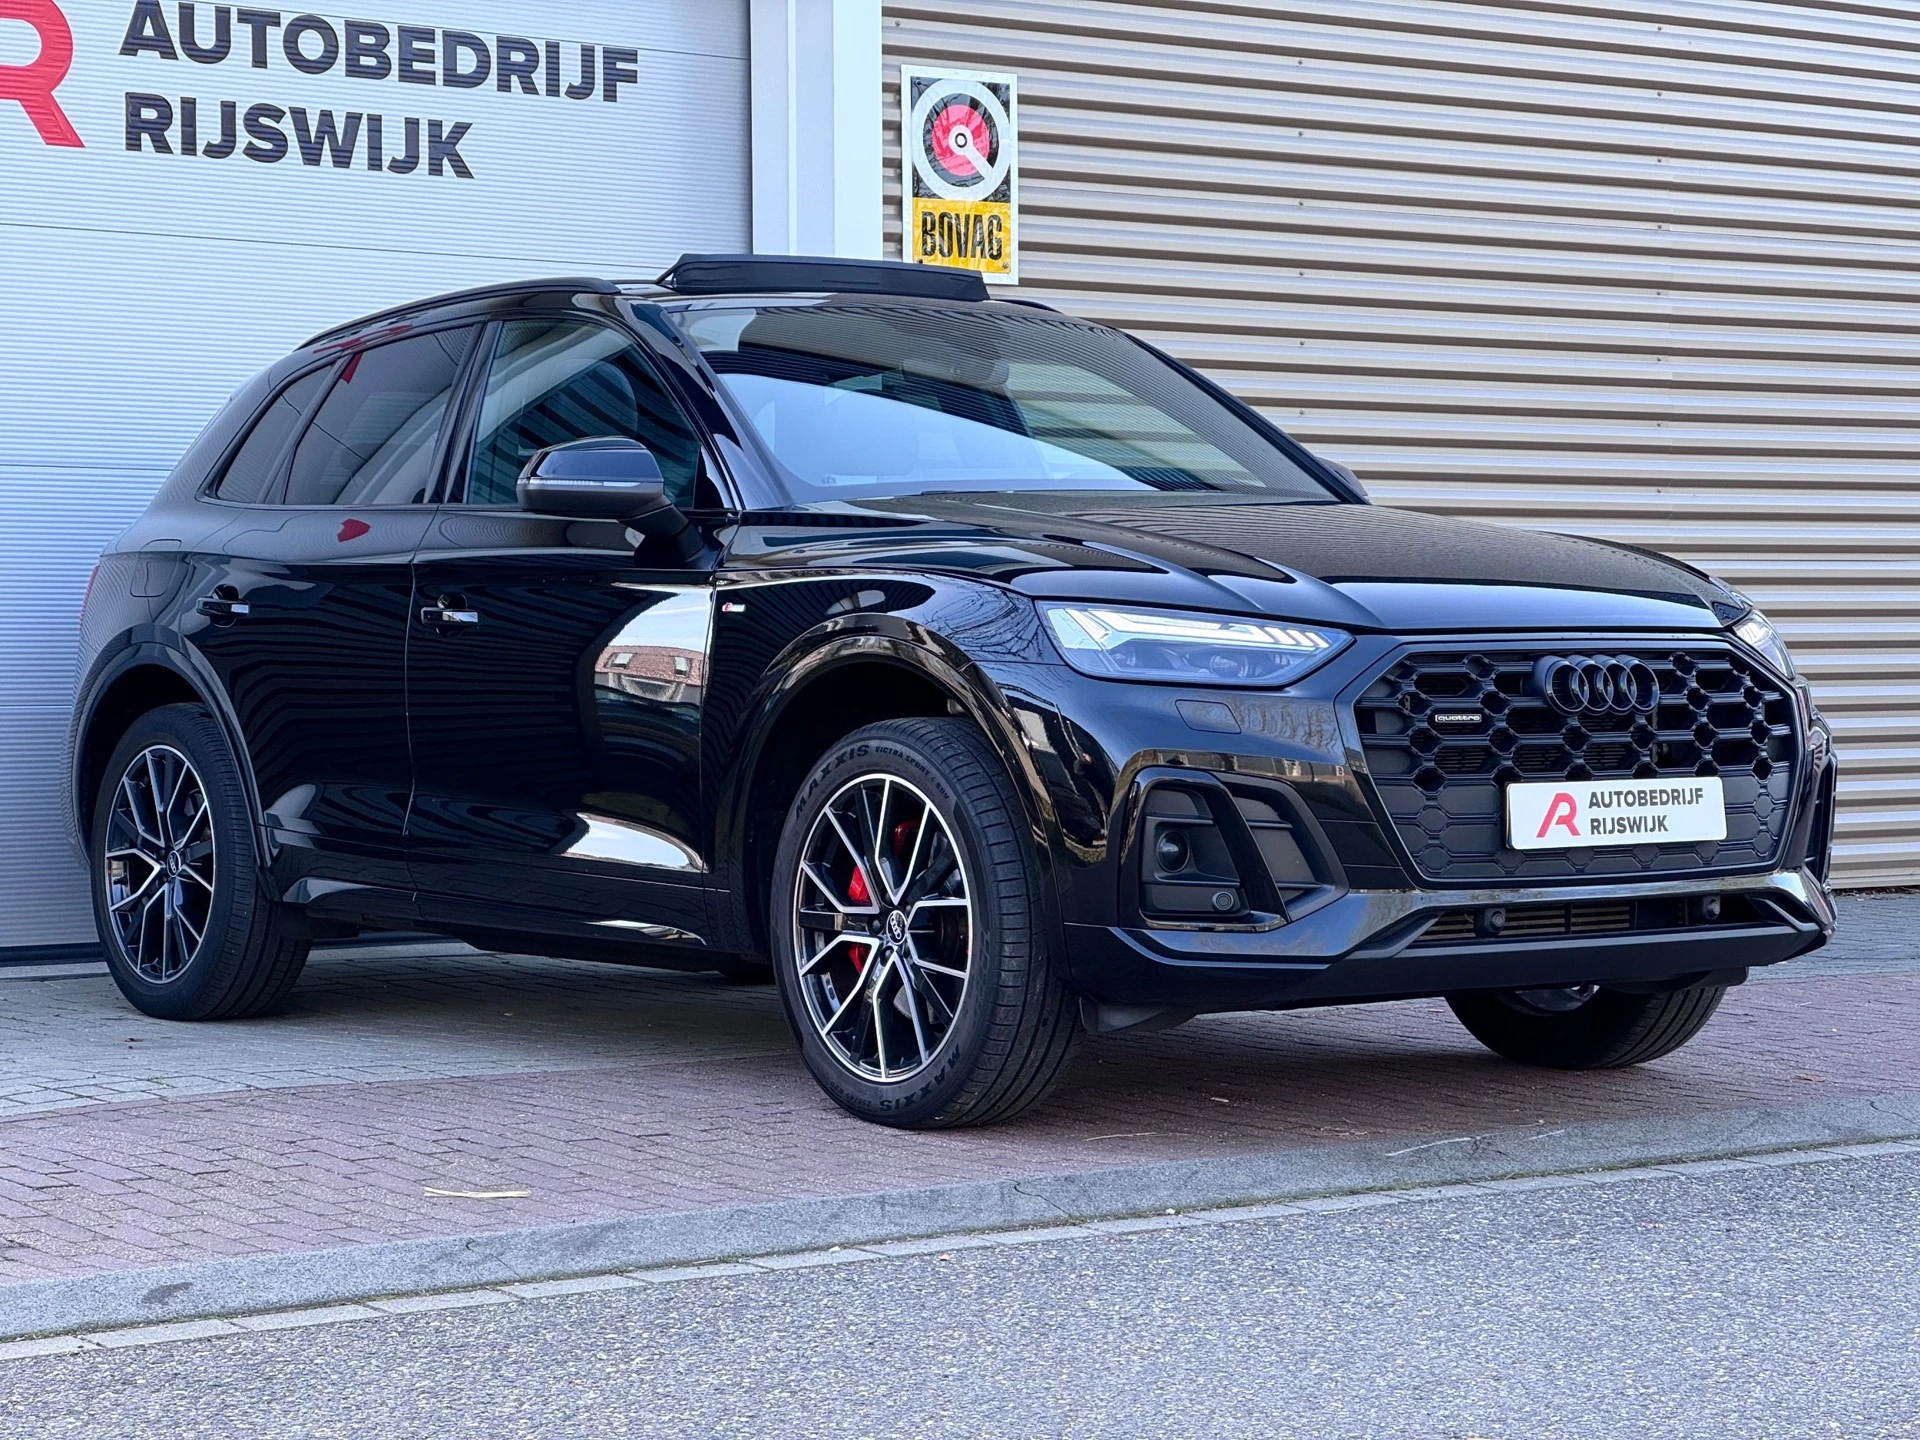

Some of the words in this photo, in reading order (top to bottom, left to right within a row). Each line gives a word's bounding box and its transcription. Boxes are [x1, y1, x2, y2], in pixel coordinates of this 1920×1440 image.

[118, 0, 639, 102] AUTOBEDRIJF
[125, 91, 474, 179] RIJSWIJK
[921, 211, 1003, 260] BOVAG
[1437, 714, 1480, 722] quattro
[795, 744, 870, 820] MAXXIS
[875, 746, 904, 759] VICTRA
[904, 754, 930, 776] SPORT
[935, 782, 950, 799] SUV
[1588, 787, 1704, 809] AUTOBEDRIJF
[1590, 814, 1669, 835] RIJSWIJK
[879, 1043, 961, 1112] MAXXIS
